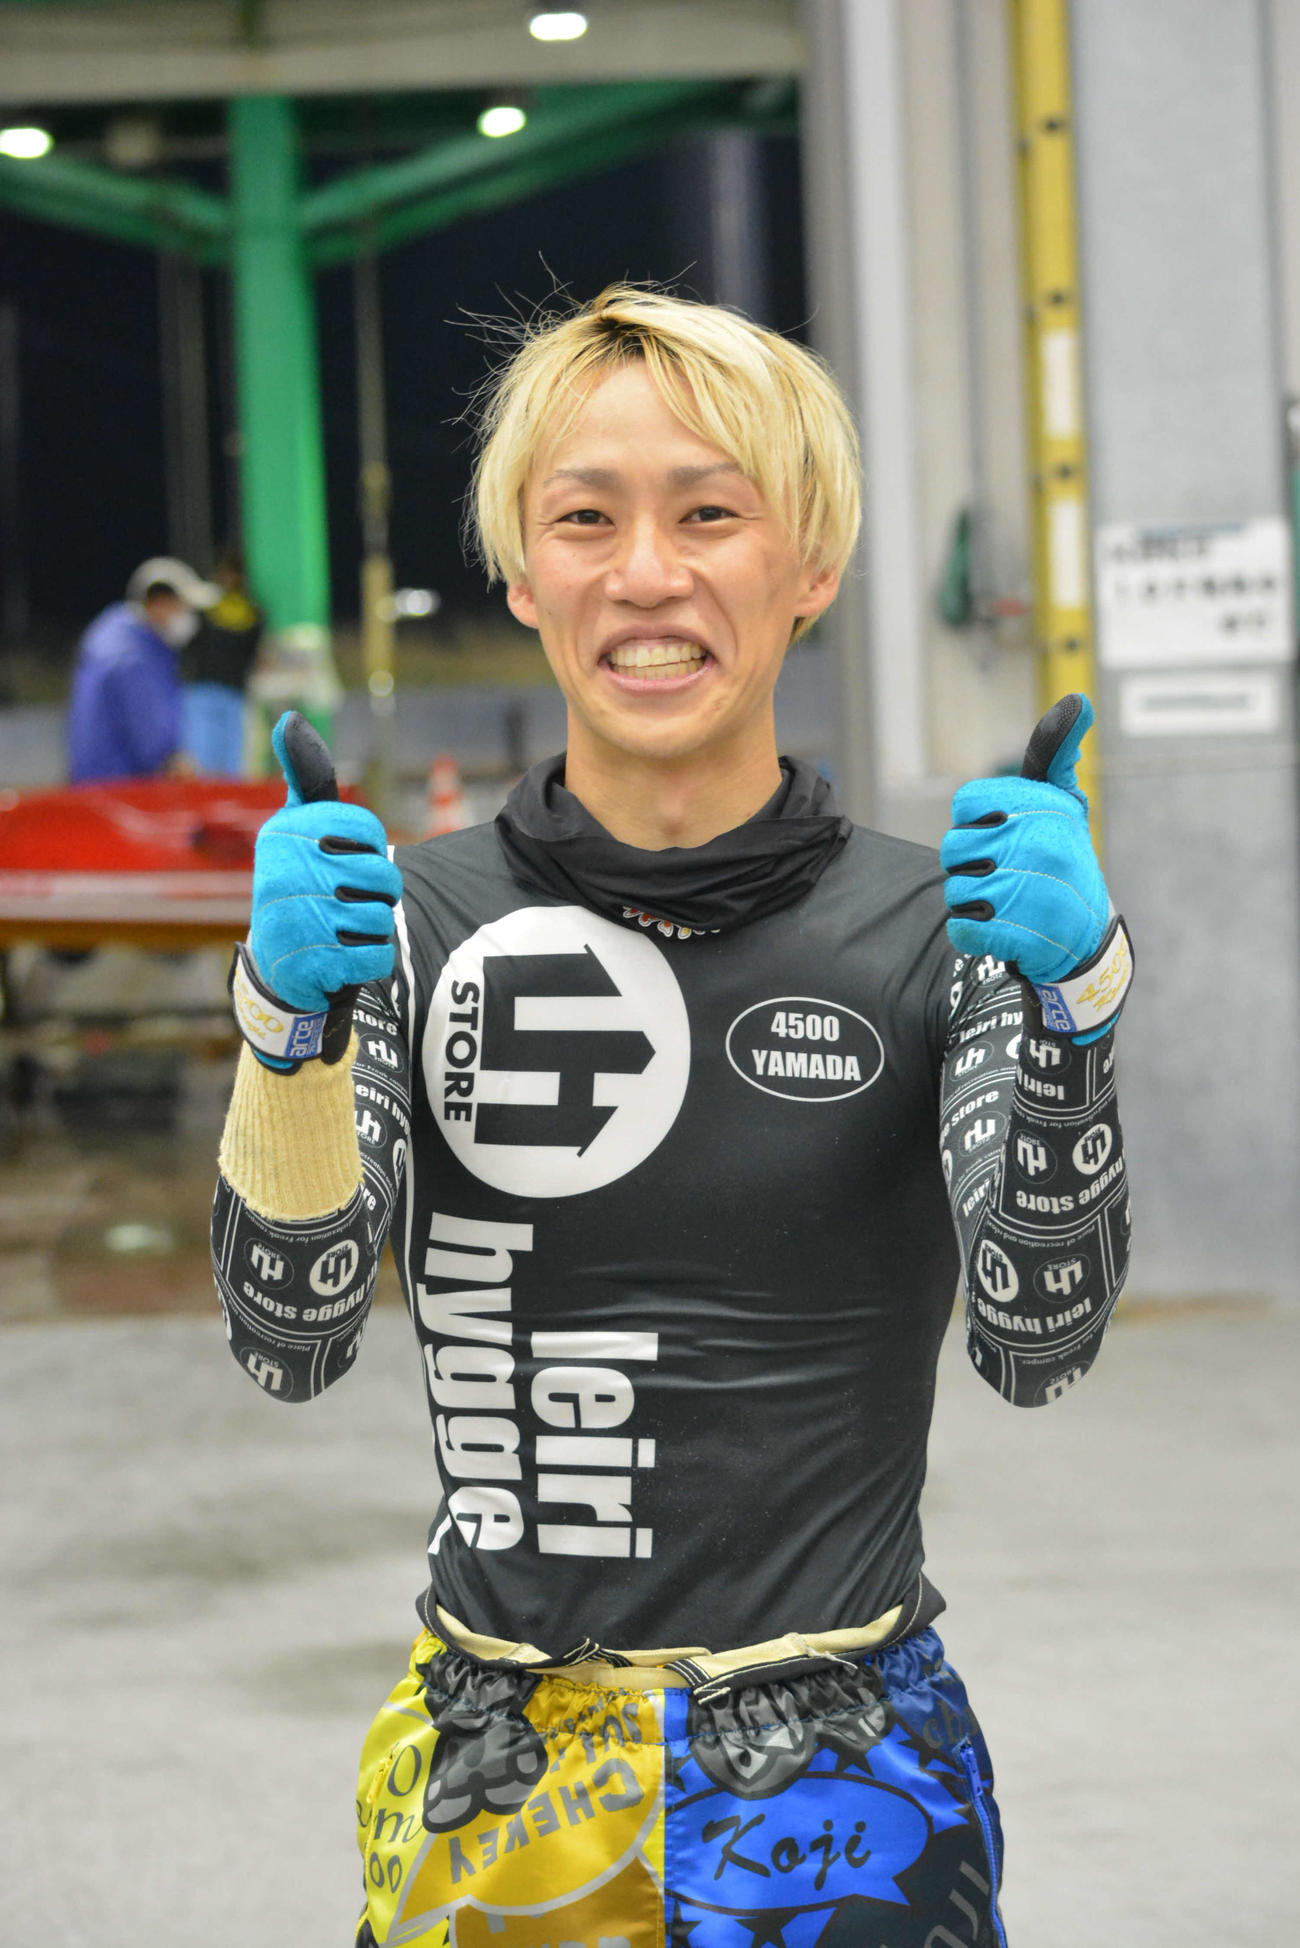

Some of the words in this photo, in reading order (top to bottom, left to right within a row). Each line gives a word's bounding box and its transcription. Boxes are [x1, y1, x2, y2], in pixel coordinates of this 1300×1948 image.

[770, 1010, 839, 1042] 4500
[444, 980, 479, 1123] STORE
[751, 1049, 862, 1082] YAMADA
[352, 1080, 391, 1110] eiri
[1023, 1072, 1065, 1101] leiri
[951, 1090, 1000, 1127] store
[1079, 1155, 1124, 1206] hygge
[1015, 1190, 1075, 1215] store
[243, 1281, 298, 1320] store
[302, 1282, 366, 1322] hygge
[977, 1298, 1043, 1335] hygge
[1045, 1296, 1092, 1333] leiri
[416, 1211, 534, 1552] hygge
[529, 1331, 660, 1559] leiri
[449, 1756, 645, 1886] CHEKEY
[701, 1813, 872, 1888] Koji
